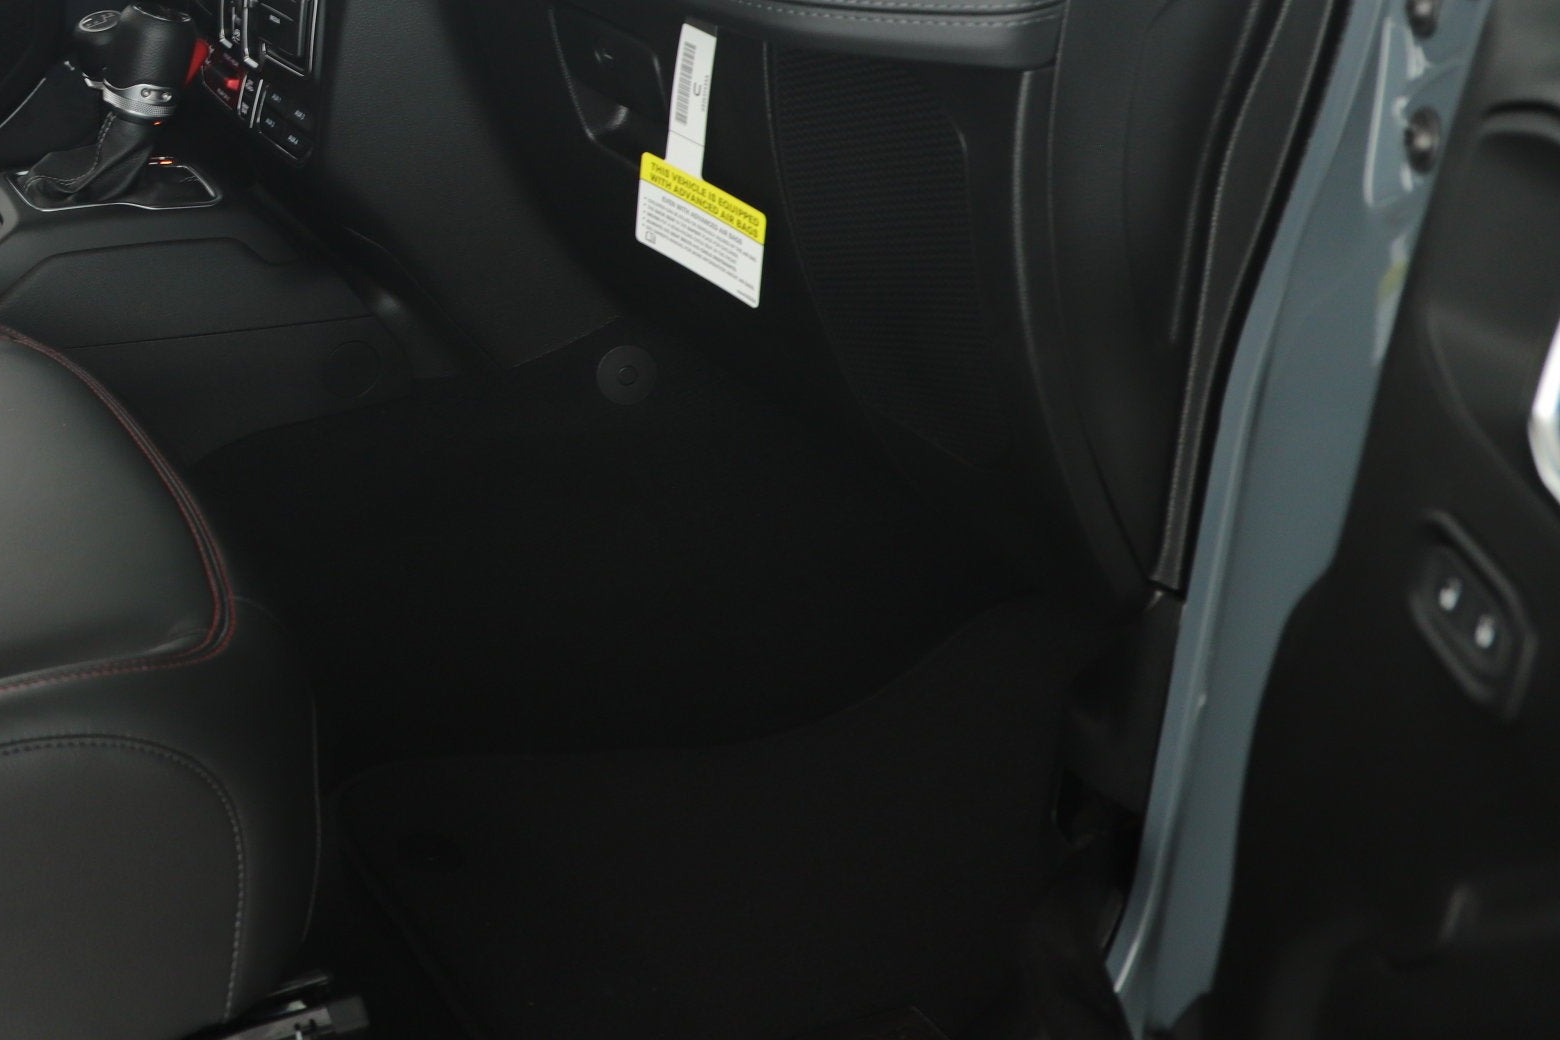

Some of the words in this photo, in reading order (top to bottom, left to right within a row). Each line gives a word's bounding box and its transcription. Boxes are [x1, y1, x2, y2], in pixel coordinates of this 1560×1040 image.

[650, 162, 670, 178] THIS
[672, 174, 706, 197] VEHICLE
[708, 192, 717, 203] IS
[718, 197, 759, 227] EQUIPPED
[650, 173, 672, 190] WITH
[673, 186, 719, 215] ADVANCED
[721, 211, 735, 225] AIR
[737, 220, 758, 239] BAGS
